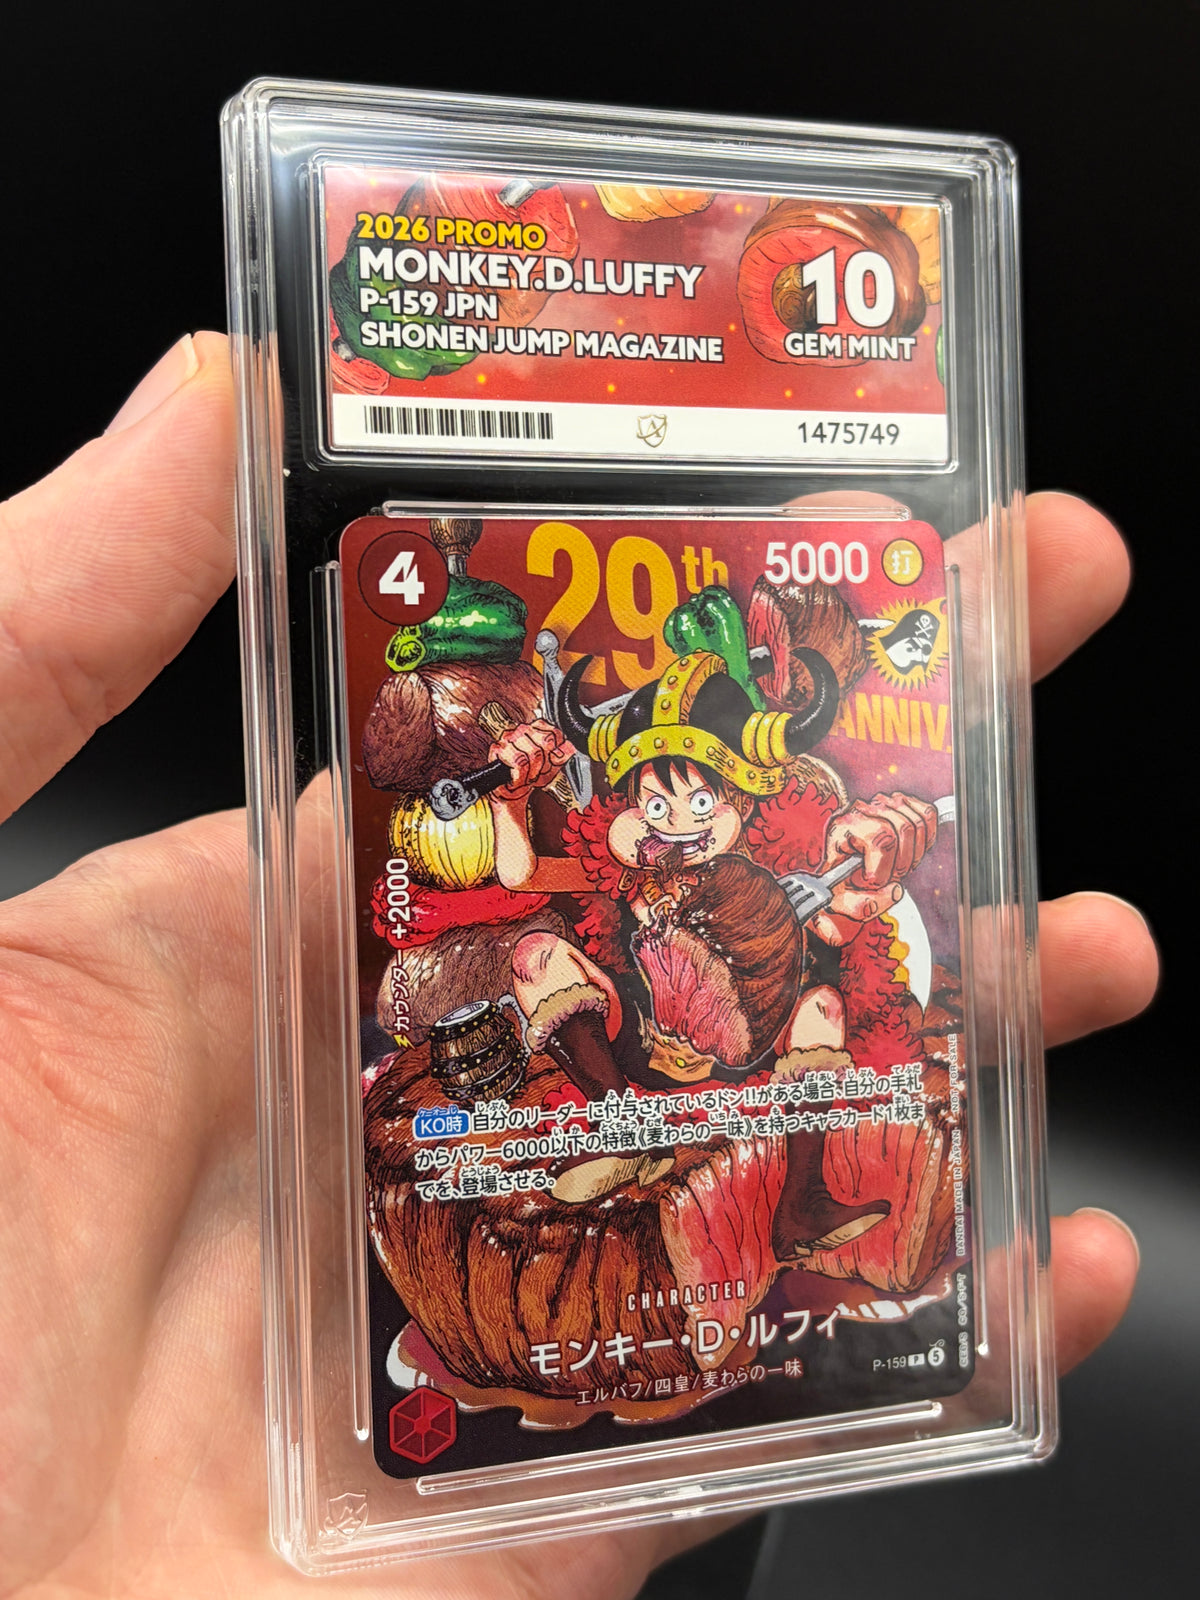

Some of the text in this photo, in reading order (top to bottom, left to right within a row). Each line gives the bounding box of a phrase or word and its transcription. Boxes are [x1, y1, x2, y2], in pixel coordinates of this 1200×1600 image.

[356, 212, 547, 250] 2026 PROMO
[358, 245, 705, 298] MONKEY.D.LUFFY
[802, 247, 895, 328] 10
[359, 287, 498, 320] P-159 JPN
[360, 320, 724, 362] SHONEN JUMP MAGAZINE
[784, 332, 916, 361] GEM MINT
[798, 421, 900, 445] 1475749
[378, 550, 426, 605] 4
[764, 541, 869, 585] 5000
[891, 549, 914, 575] 打
[386, 858, 411, 1032] カウンター +2000
[627, 1280, 746, 1311] CHARACTER
[872, 1355, 907, 1372] P-159
